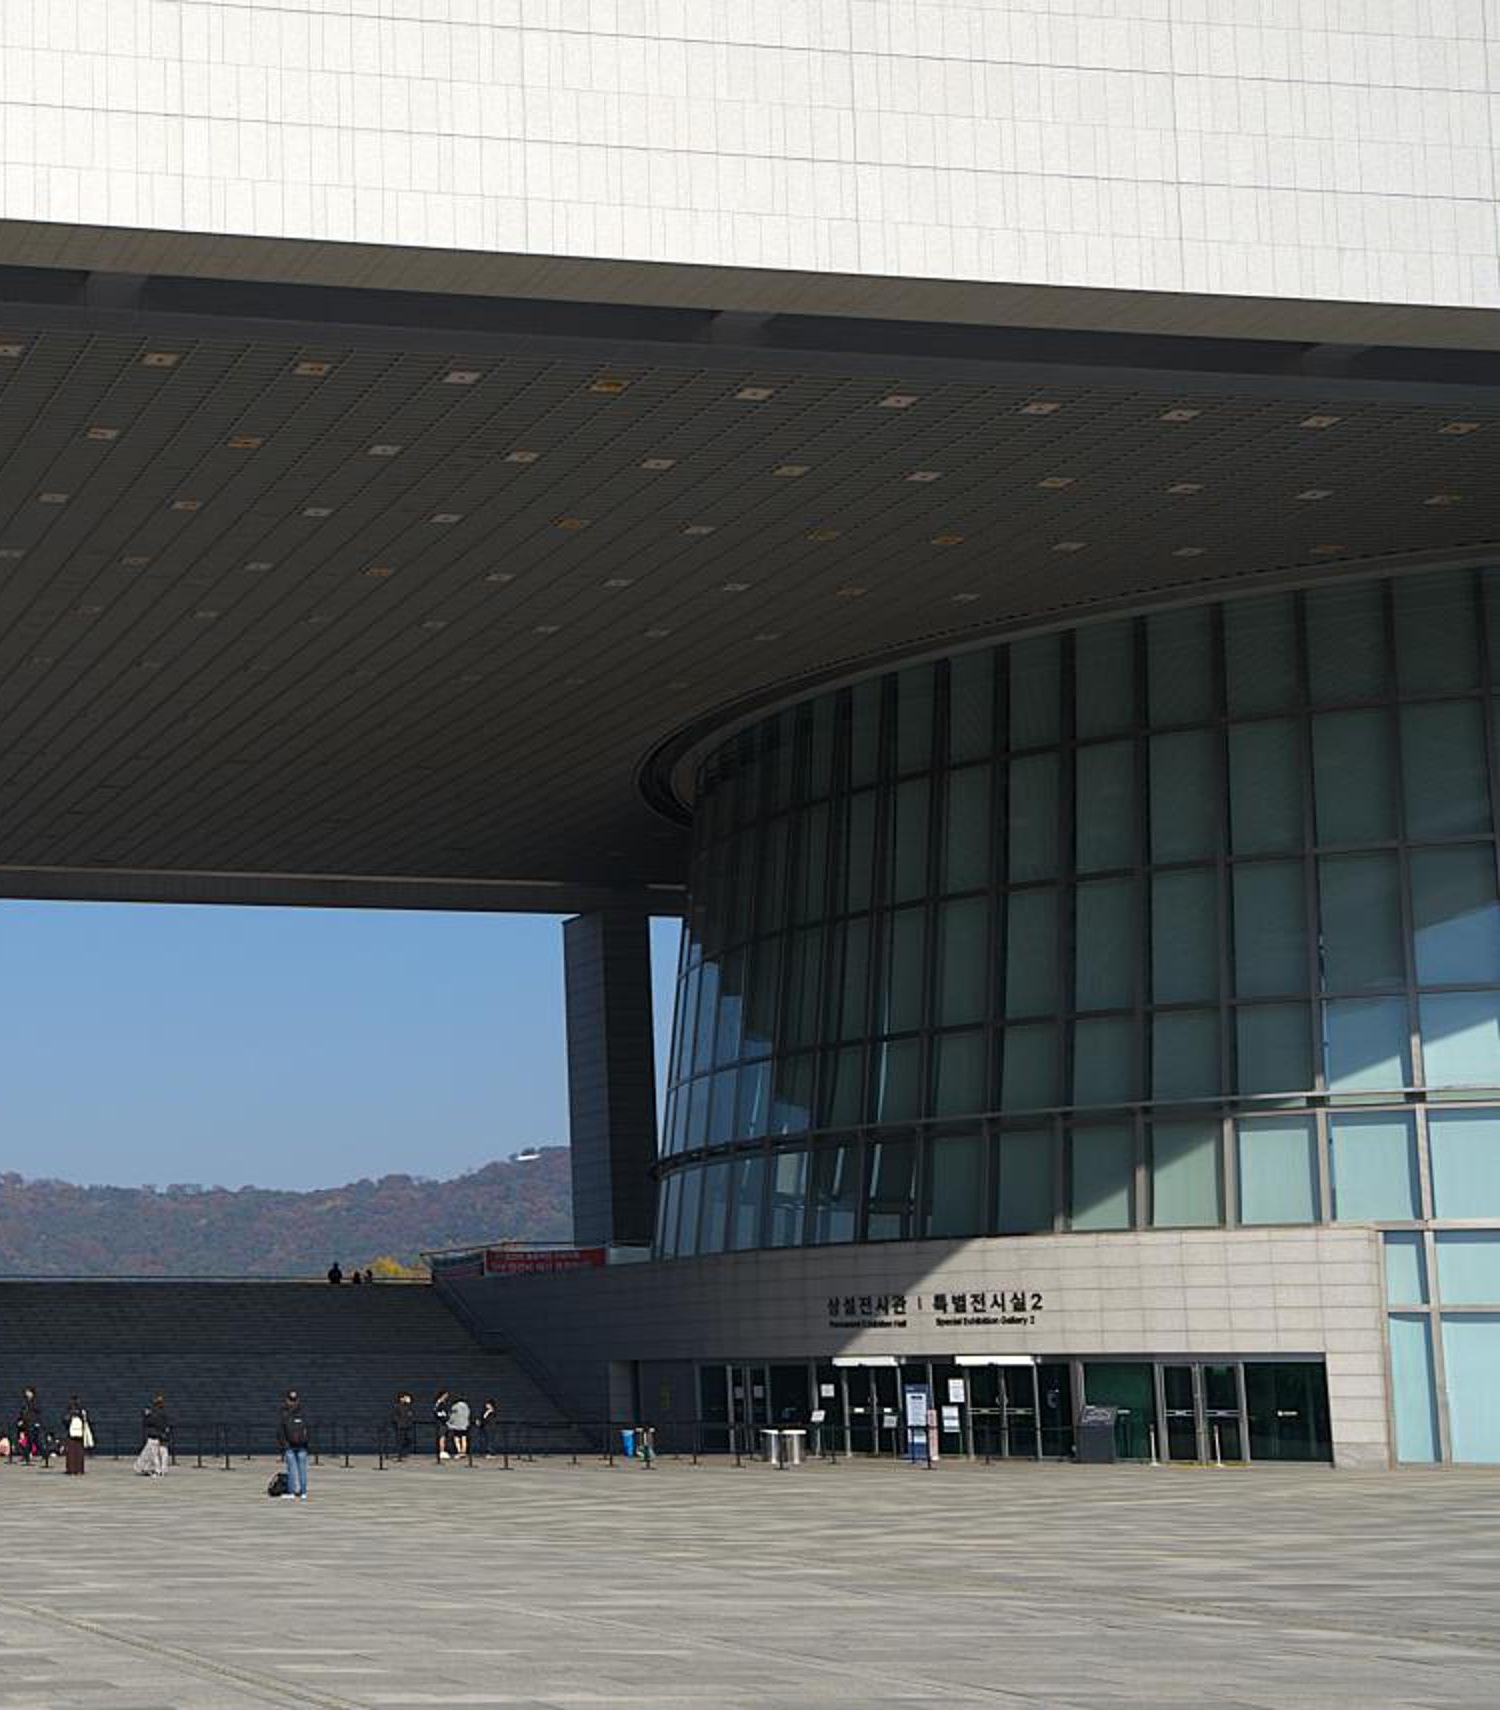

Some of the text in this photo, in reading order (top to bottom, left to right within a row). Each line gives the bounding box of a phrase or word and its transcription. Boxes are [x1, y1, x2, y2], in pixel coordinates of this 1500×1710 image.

[828, 1295, 906, 1316] 상설전시관
[936, 1317, 962, 1327] Special
[963, 1317, 998, 1326] Exhibition
[999, 1315, 1028, 1326] Gallery
